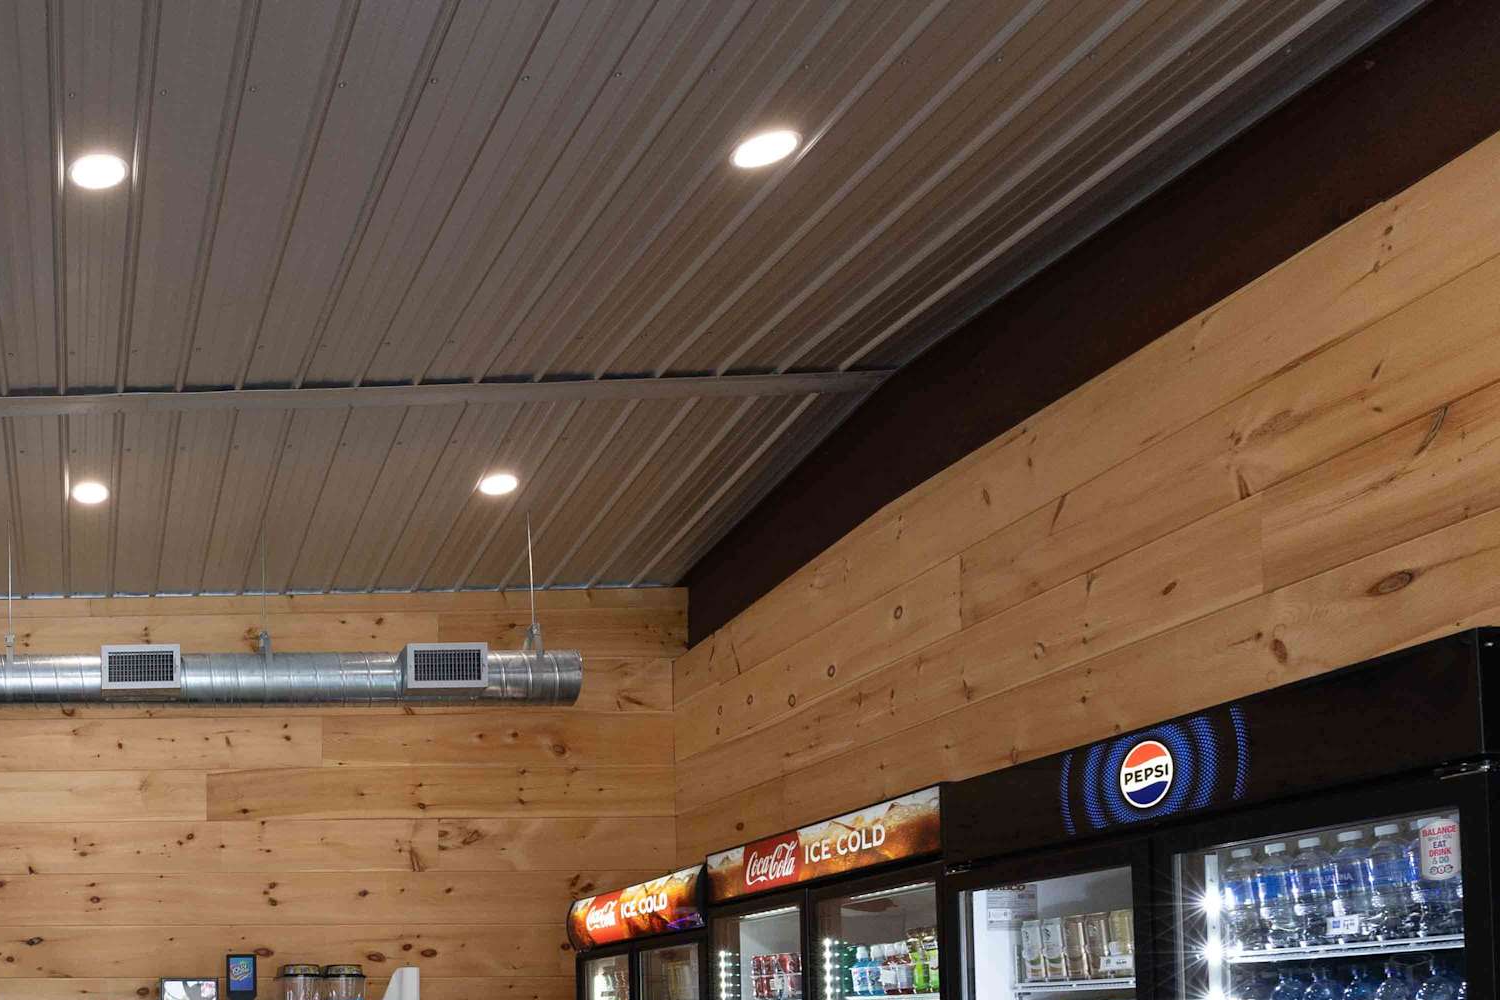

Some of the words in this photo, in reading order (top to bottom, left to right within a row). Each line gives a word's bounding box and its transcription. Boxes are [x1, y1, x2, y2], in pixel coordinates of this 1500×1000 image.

[1124, 763, 1170, 786] PEPSI
[1422, 825, 1457, 837] BALANCE
[1428, 847, 1452, 857] DRINK
[1433, 840, 1446, 848] EAT
[746, 840, 798, 885] Coca-Cola
[804, 843, 831, 865] ICE
[837, 824, 886, 856] COLD
[620, 901, 637, 919] ICE
[636, 893, 669, 916] COLD
